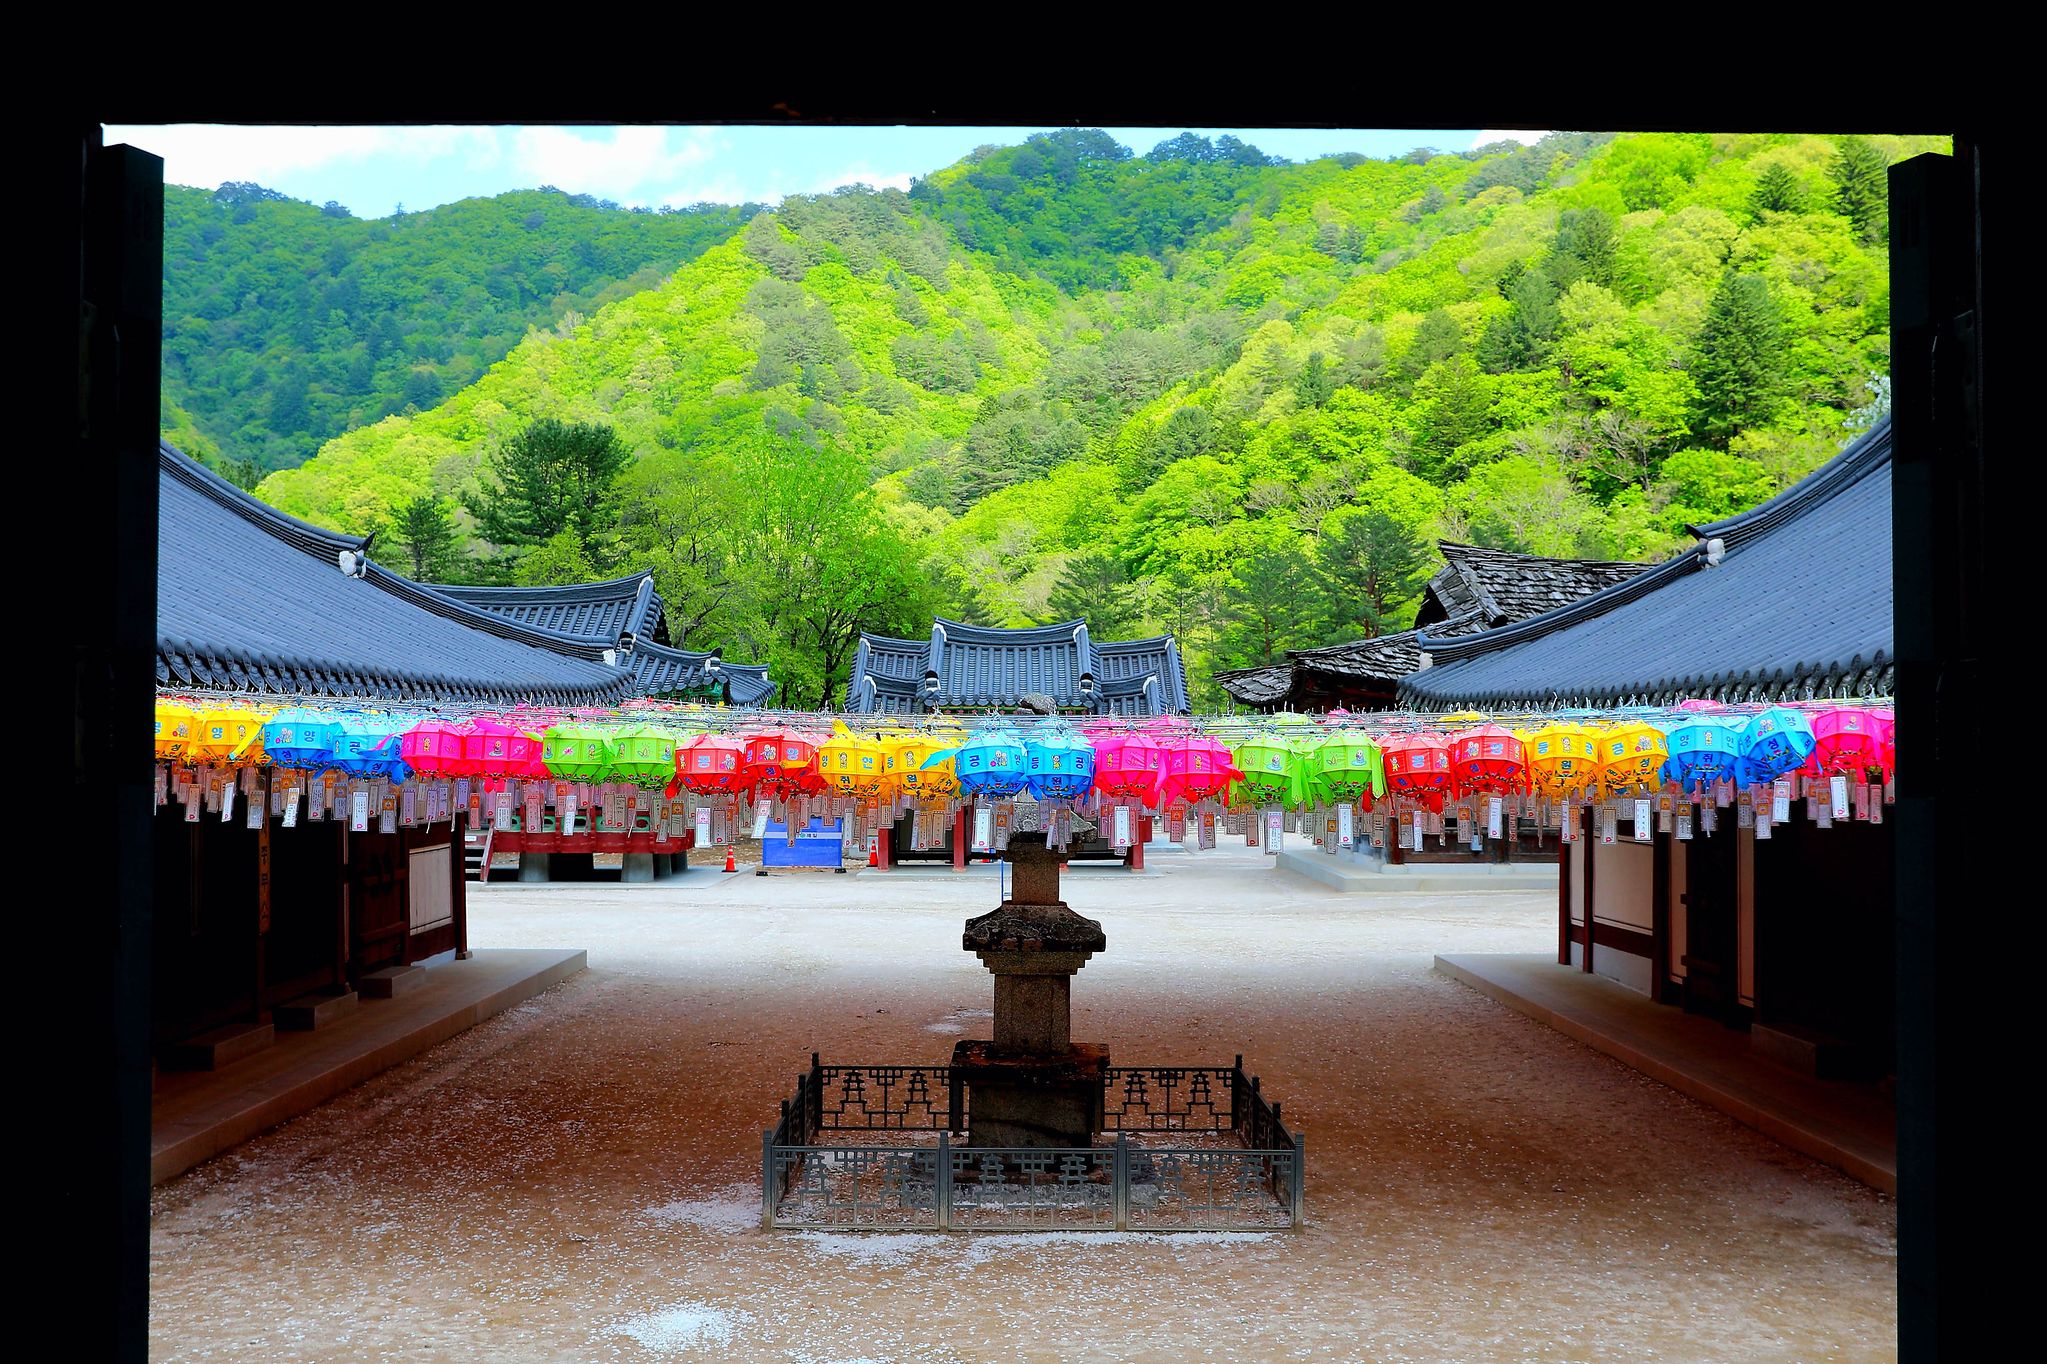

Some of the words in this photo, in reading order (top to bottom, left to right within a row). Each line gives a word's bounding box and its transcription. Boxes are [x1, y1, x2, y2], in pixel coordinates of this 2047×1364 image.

[1784, 716, 1796, 727] 양
[211, 727, 223, 739] 양
[304, 730, 316, 742] 양
[1680, 735, 1690, 746] 양
[1726, 736, 1735, 749] 연
[1768, 738, 1779, 750] 성
[1612, 742, 1624, 755] 공
[862, 757, 873, 769] 연
[969, 755, 980, 767] 공
[1076, 757, 1084, 770] 공
[1703, 753, 1713, 762] 취
